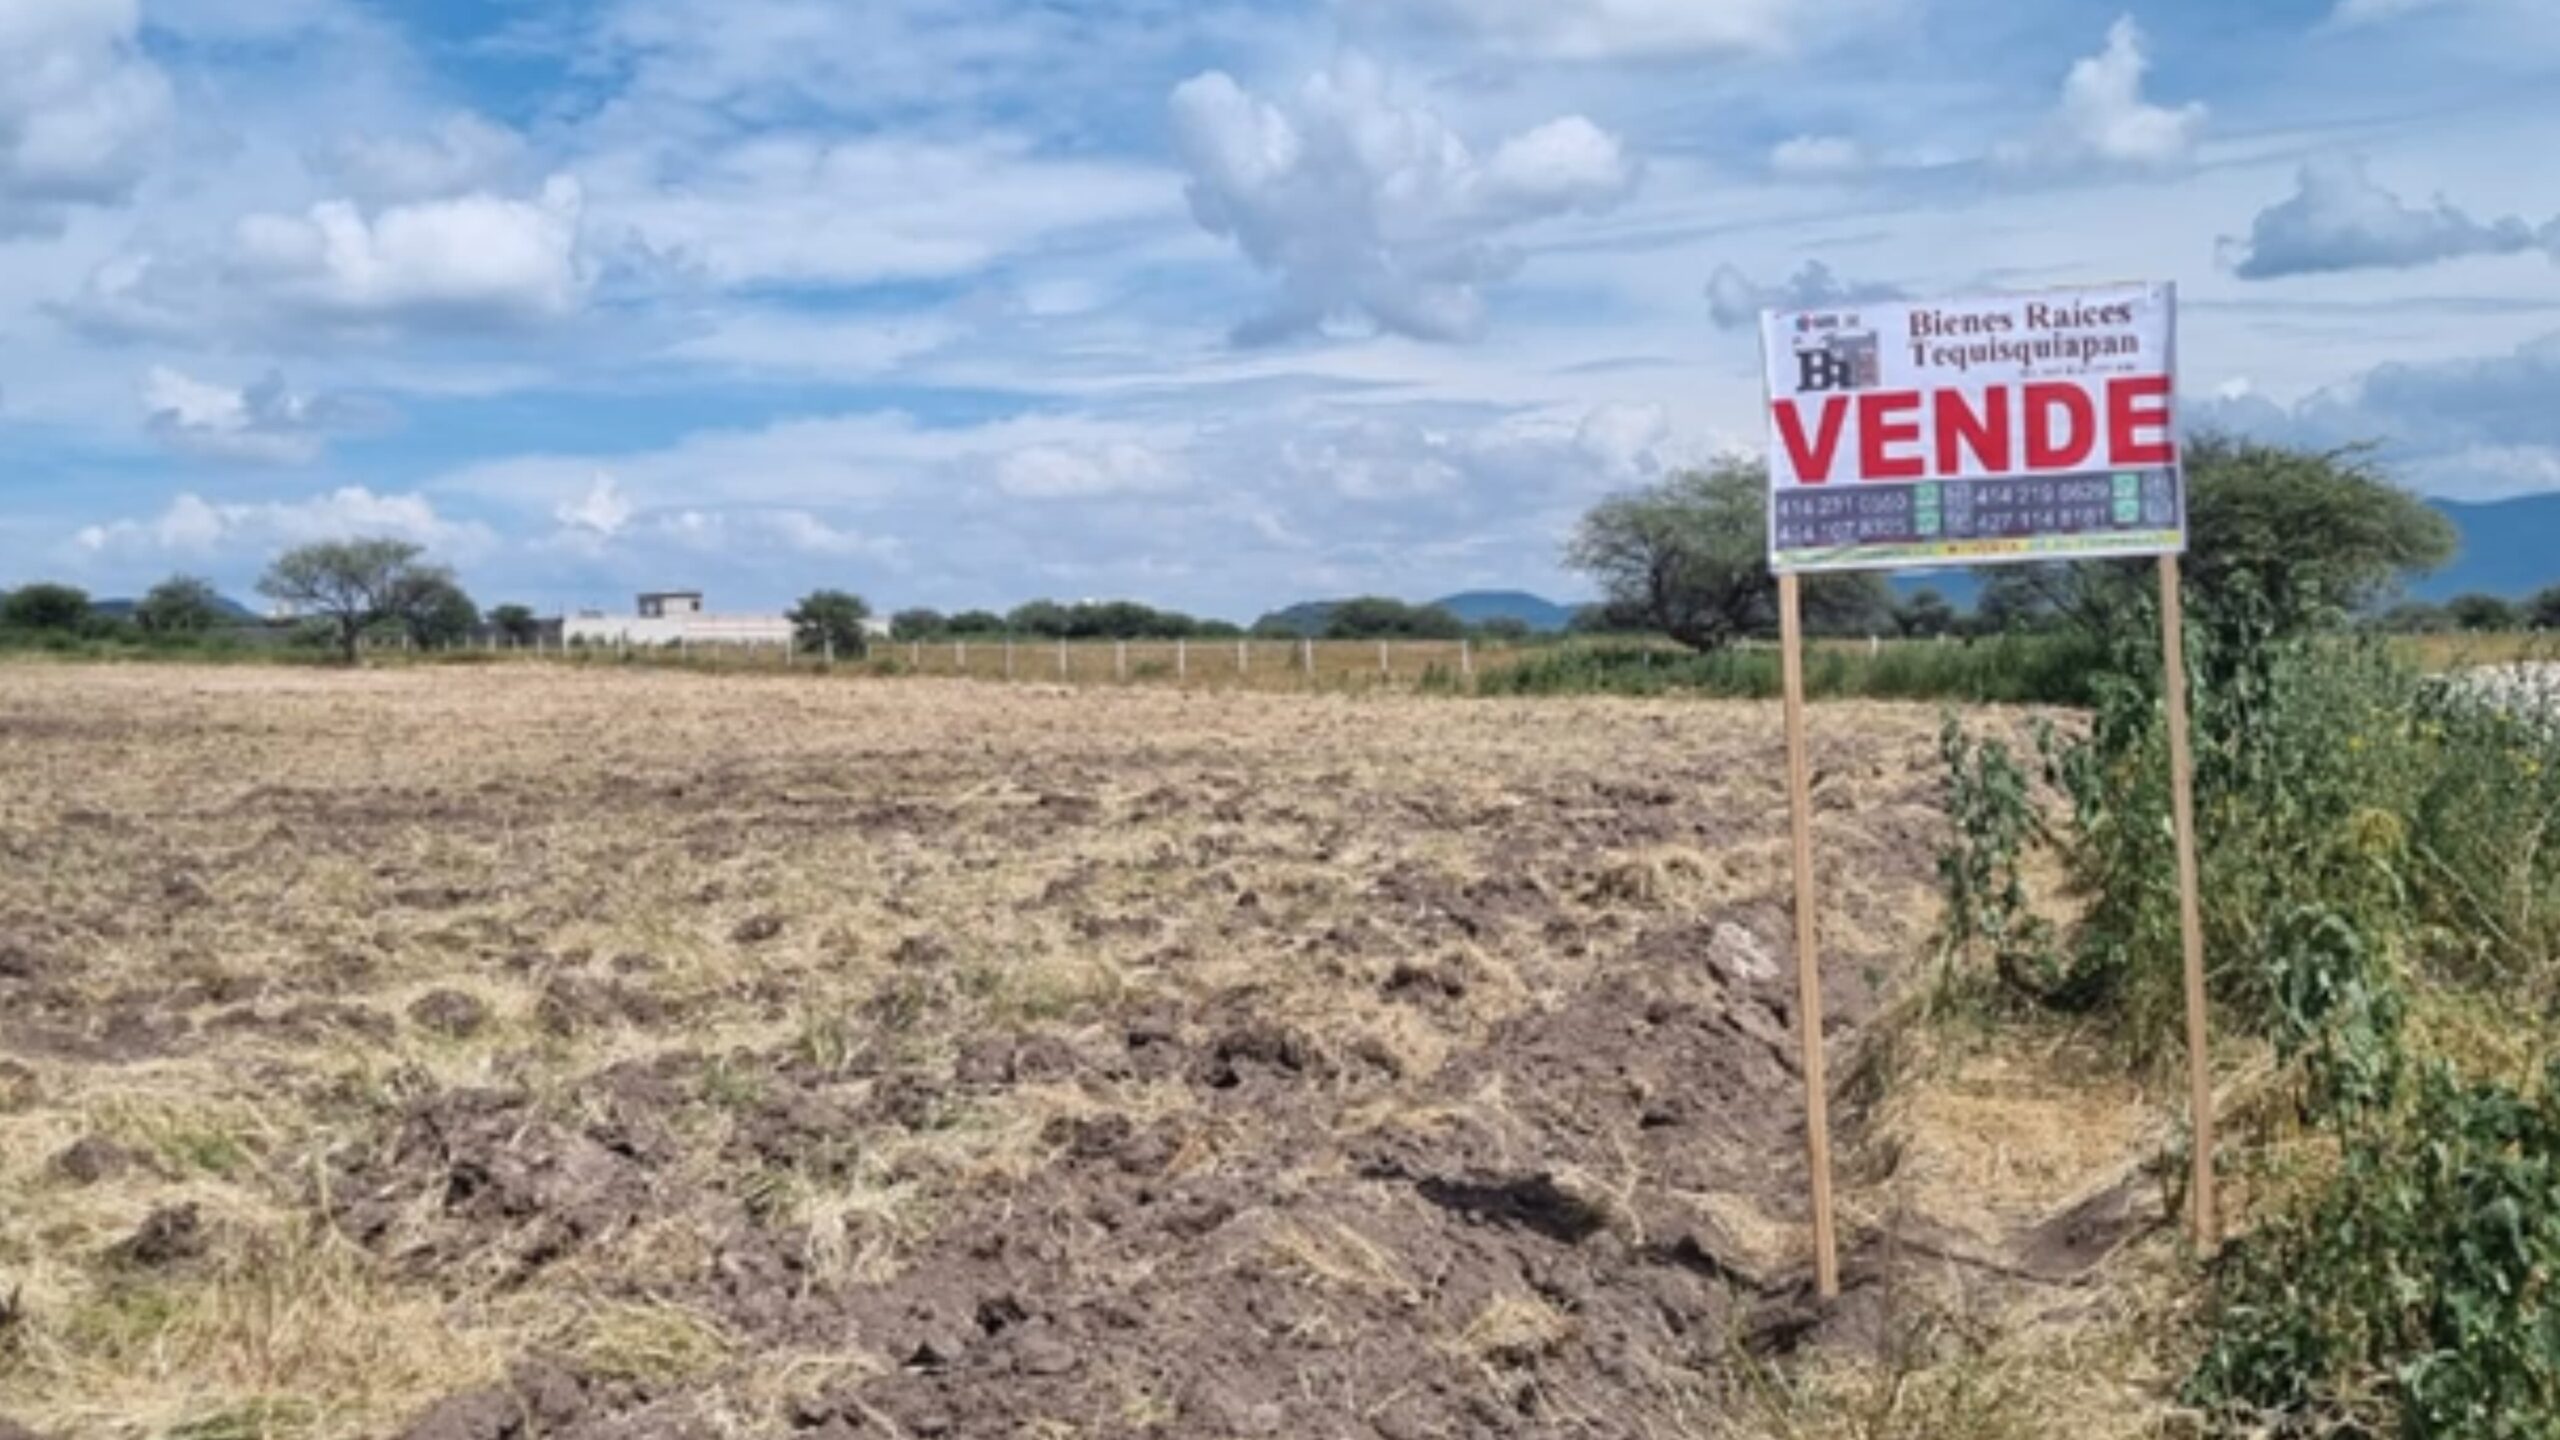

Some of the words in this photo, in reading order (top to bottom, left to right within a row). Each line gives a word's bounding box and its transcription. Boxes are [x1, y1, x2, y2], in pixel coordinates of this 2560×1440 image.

[1909, 310, 2013, 337] Bienes
[1907, 331, 2139, 371] Tequisquiapan
[1770, 374, 2176, 484] VENDE
[1976, 485, 2011, 505] 414
